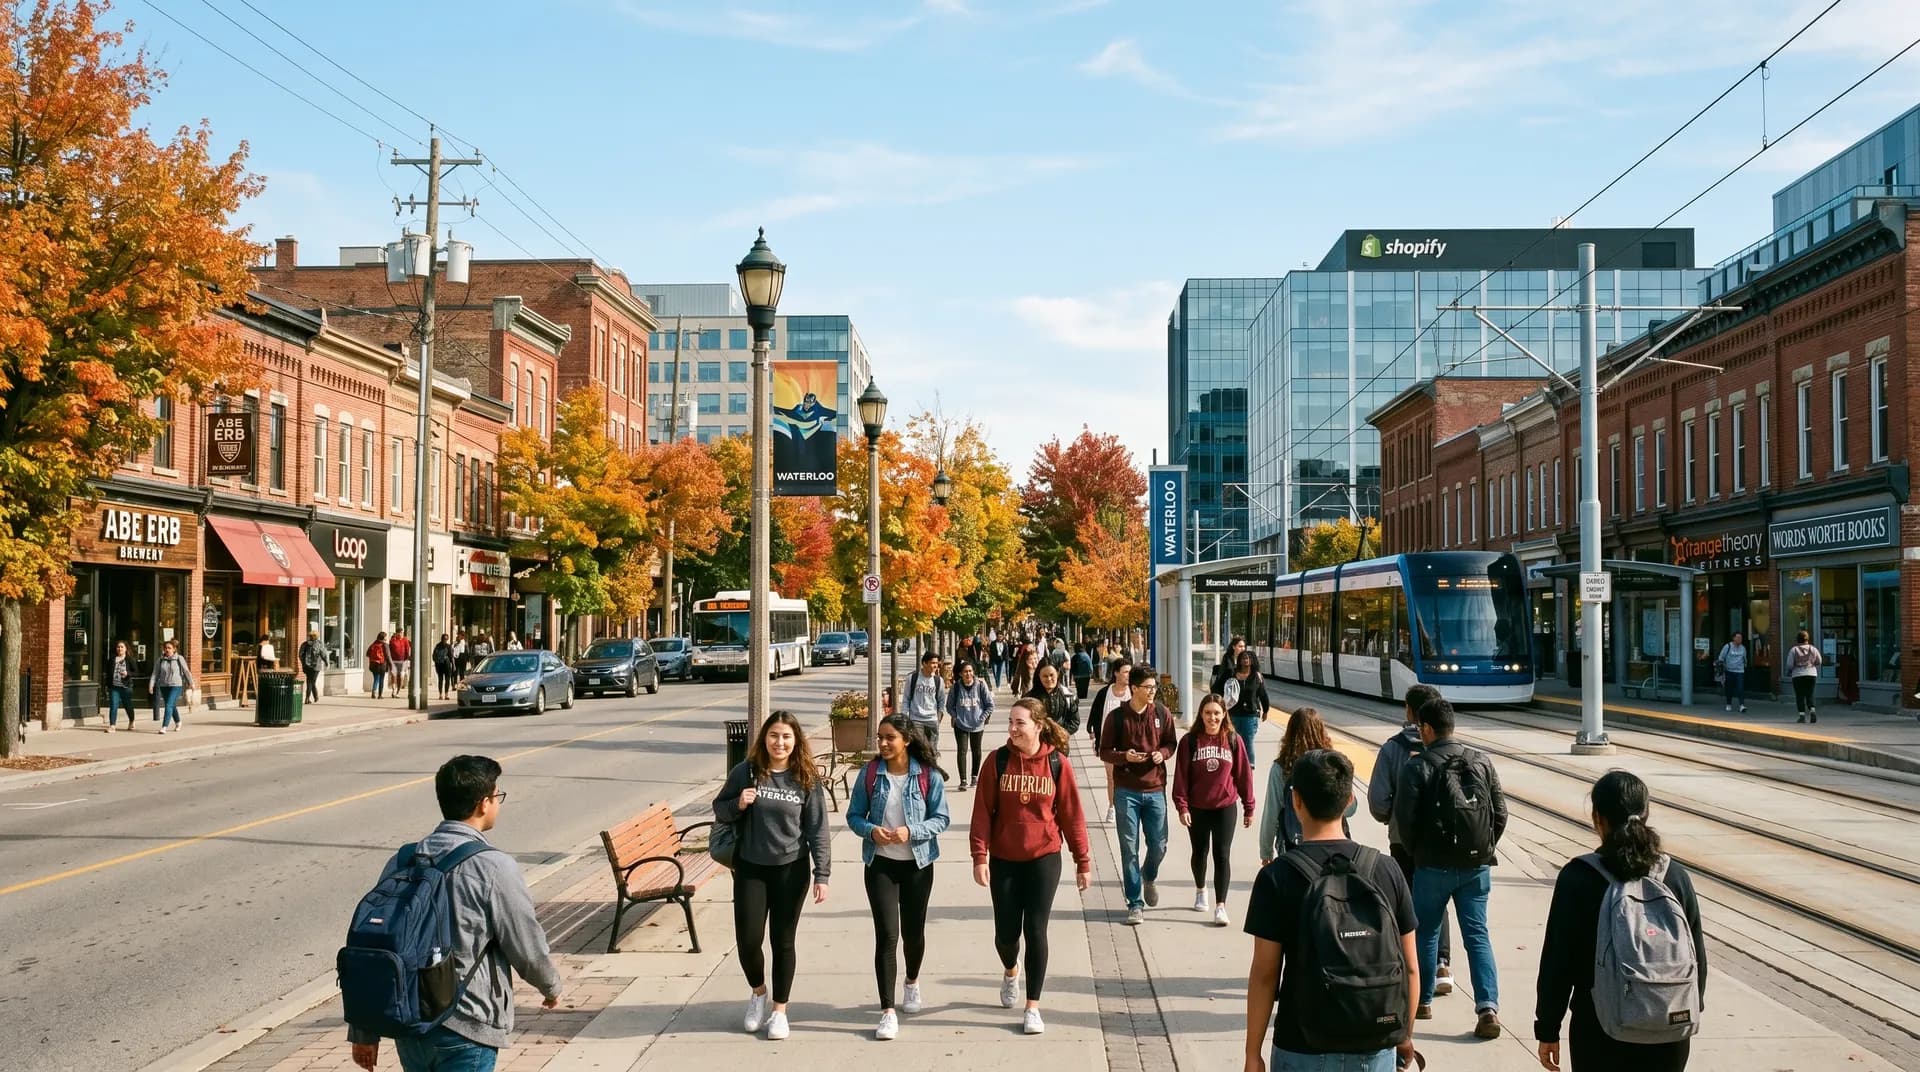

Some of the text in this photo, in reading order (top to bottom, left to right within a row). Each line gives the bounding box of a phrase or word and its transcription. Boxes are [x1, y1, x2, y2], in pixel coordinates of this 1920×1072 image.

[1385, 238, 1447, 258] shopify
[216, 418, 243, 428] ABE
[214, 428, 245, 441] ERB
[776, 471, 835, 481] WATERLOO
[1164, 479, 1177, 557] WATERLOO
[104, 509, 181, 545] ABE ERB
[1772, 516, 1886, 550] WORDS WORTH BOOKS
[119, 546, 164, 561] BREWERY
[1000, 774, 1053, 796] WATERLOO
[756, 790, 801, 803] ATERLOO
